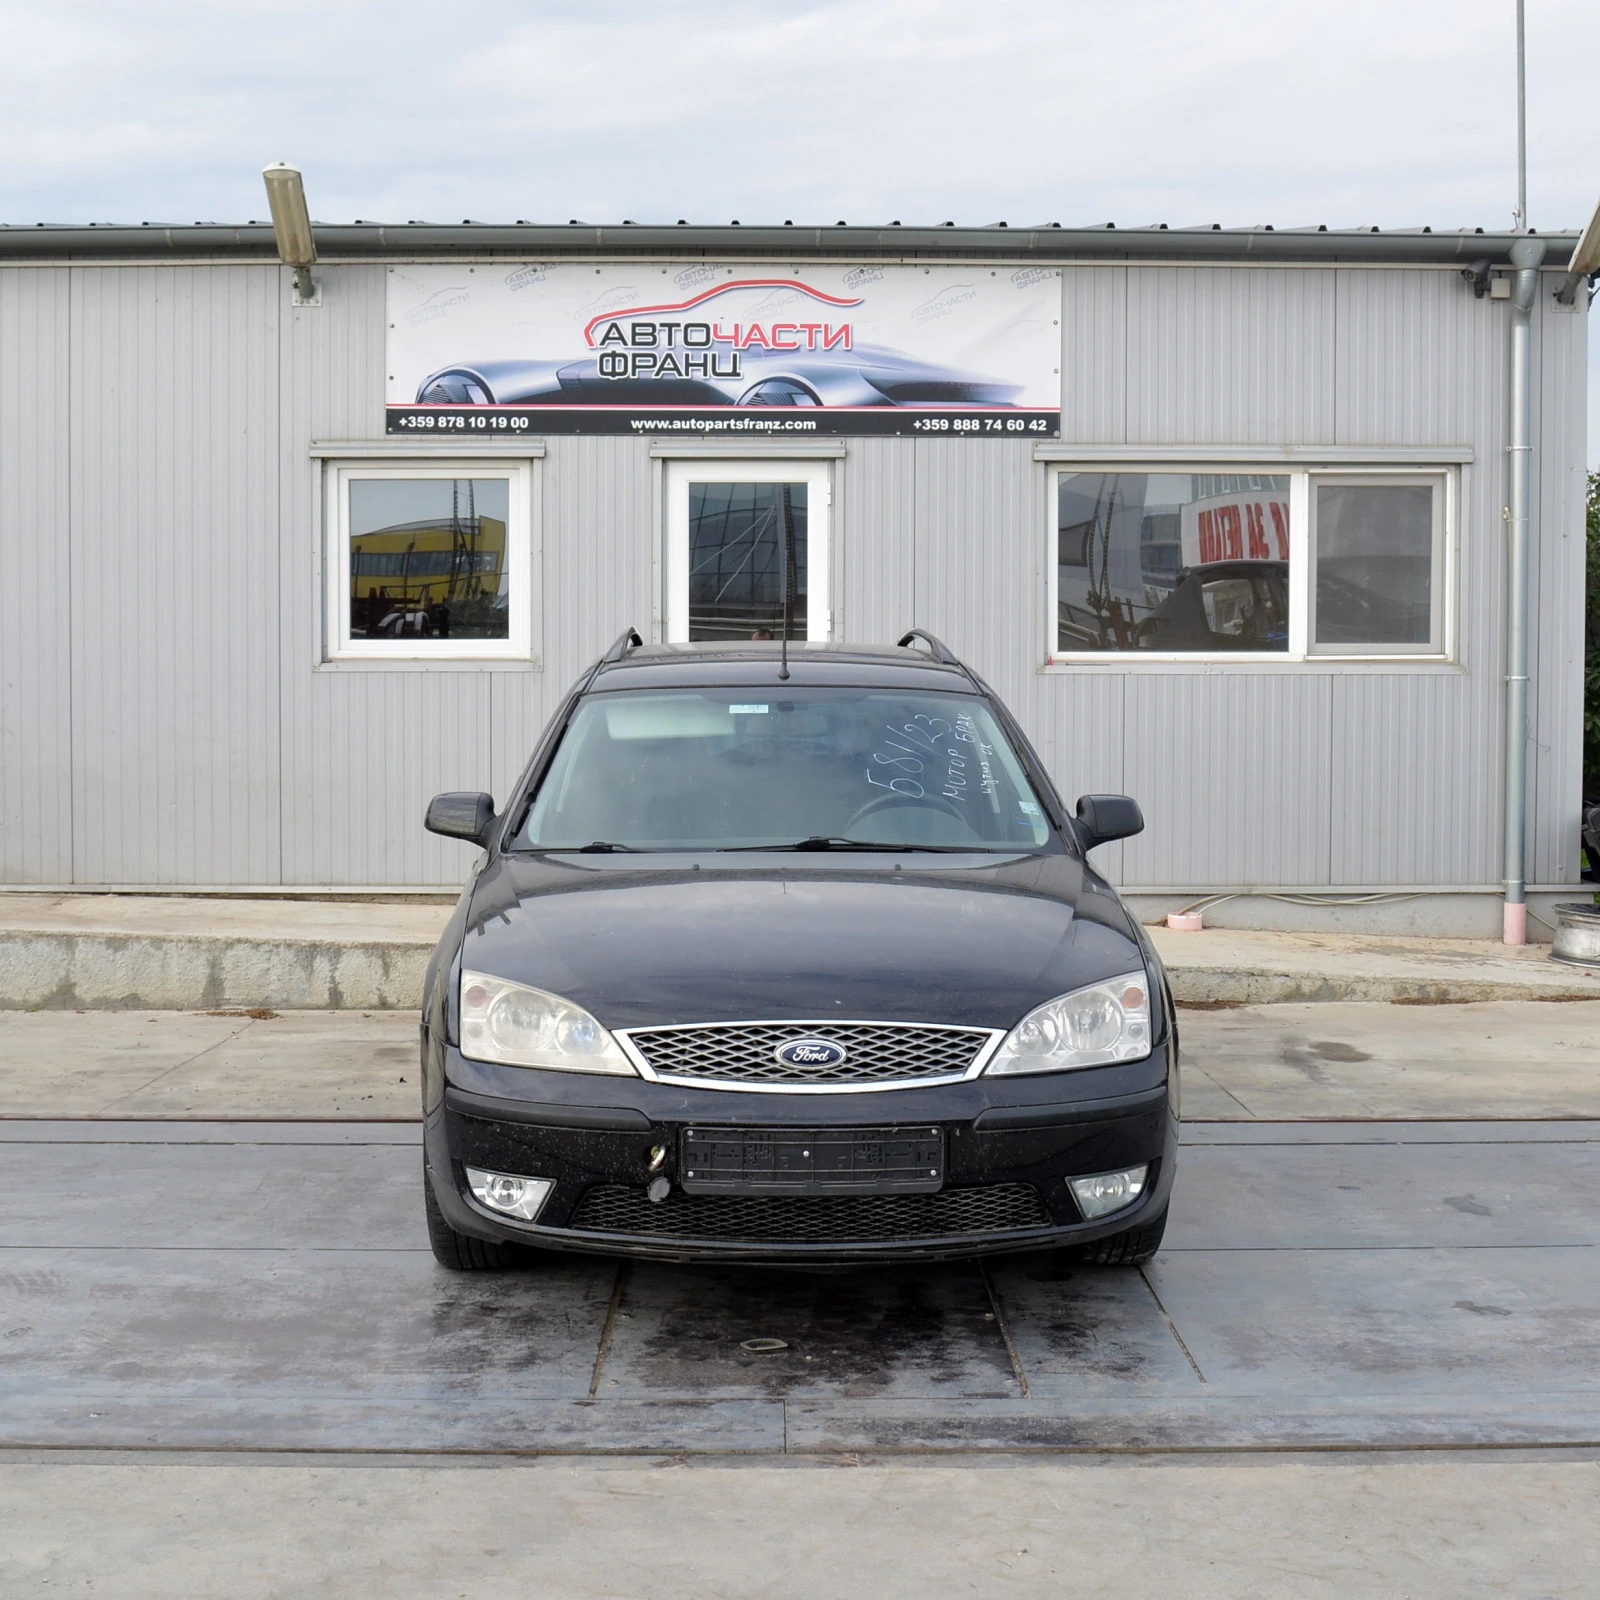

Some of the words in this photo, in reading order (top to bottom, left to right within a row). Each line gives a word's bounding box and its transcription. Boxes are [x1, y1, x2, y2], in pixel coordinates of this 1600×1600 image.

[600, 322, 851, 348] АВТОЧАСТИ
[599, 350, 742, 379] ФРАНЦ
[399, 416, 435, 428] +359
[438, 416, 465, 428] 878
[468, 416, 486, 428] 10
[489, 416, 507, 428] 19
[510, 416, 529, 429] 00
[631, 418, 816, 431] www.autopartsfranz.com
[913, 418, 949, 431] +359
[953, 418, 980, 431] 888
[984, 419, 1002, 431] 74
[1006, 419, 1025, 431] 60
[1028, 419, 1047, 431] 42
[792, 1046, 830, 1063] Ford
